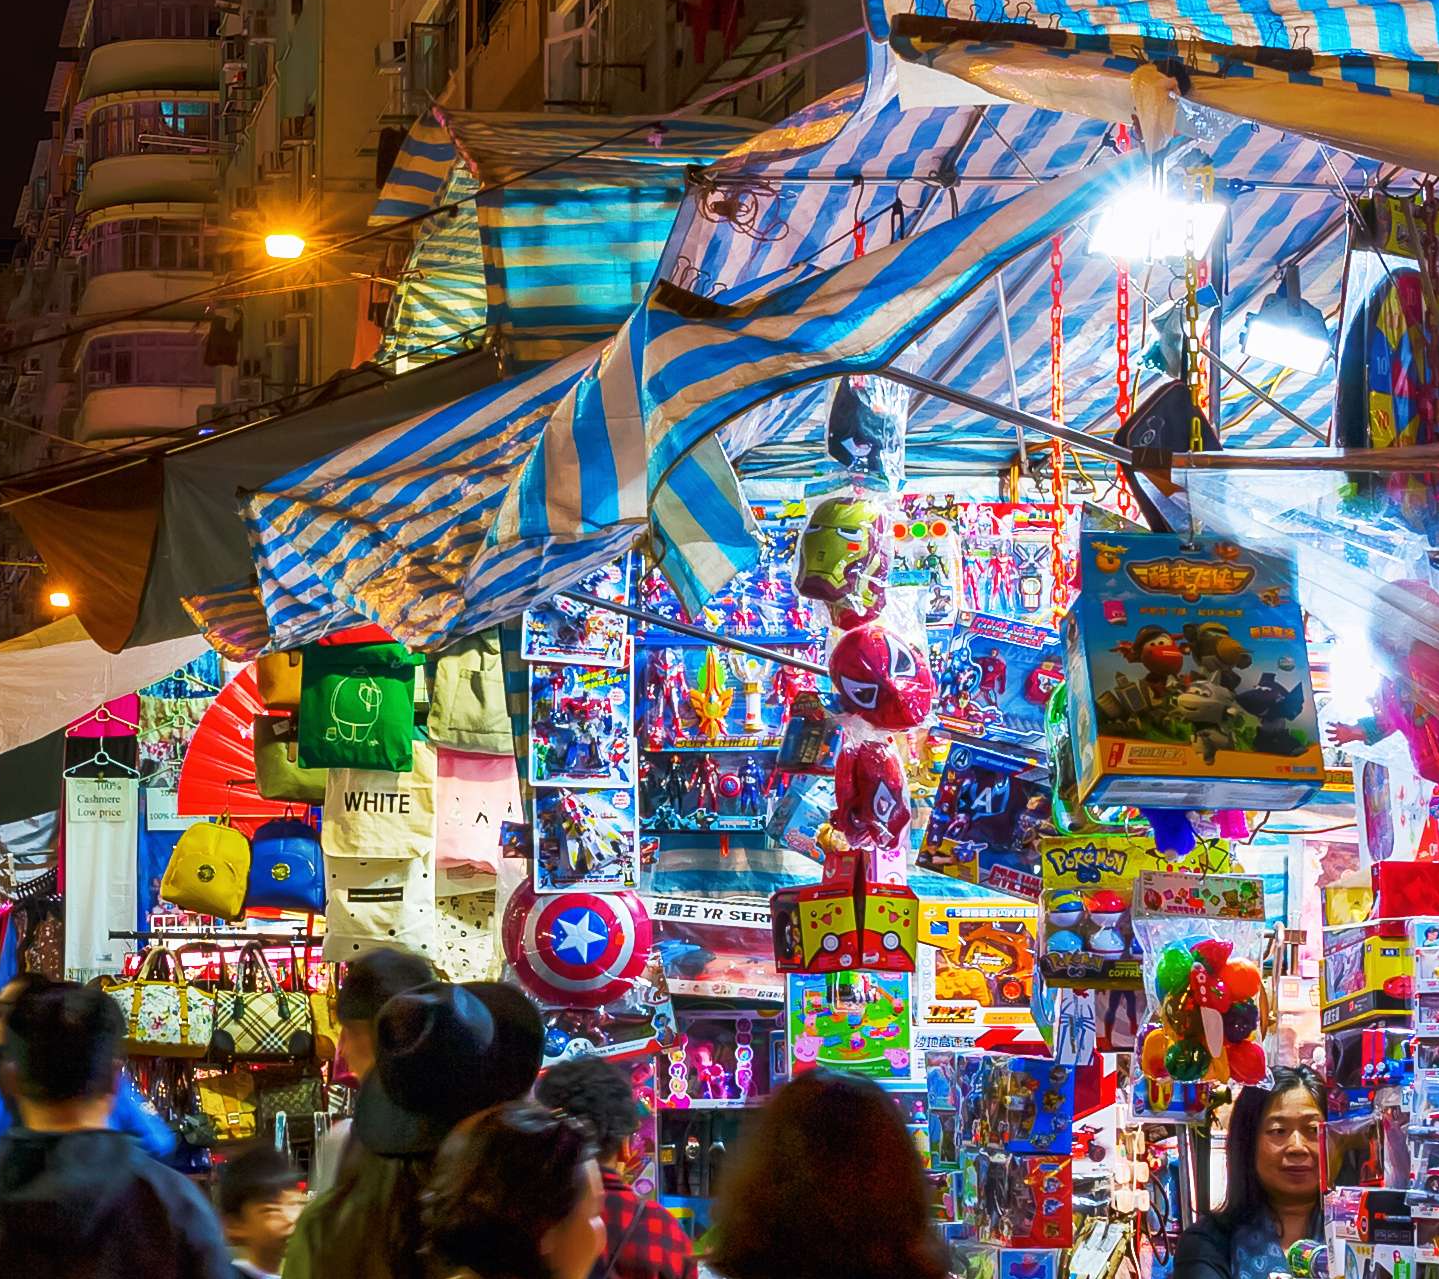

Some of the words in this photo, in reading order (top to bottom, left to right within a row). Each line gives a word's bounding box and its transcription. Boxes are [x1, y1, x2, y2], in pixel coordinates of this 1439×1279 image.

[77, 794, 121, 804] Cashmere
[345, 792, 410, 814] WHITE
[77, 807, 97, 817] Low
[99, 808, 122, 819] price
[703, 907, 724, 920] YR
